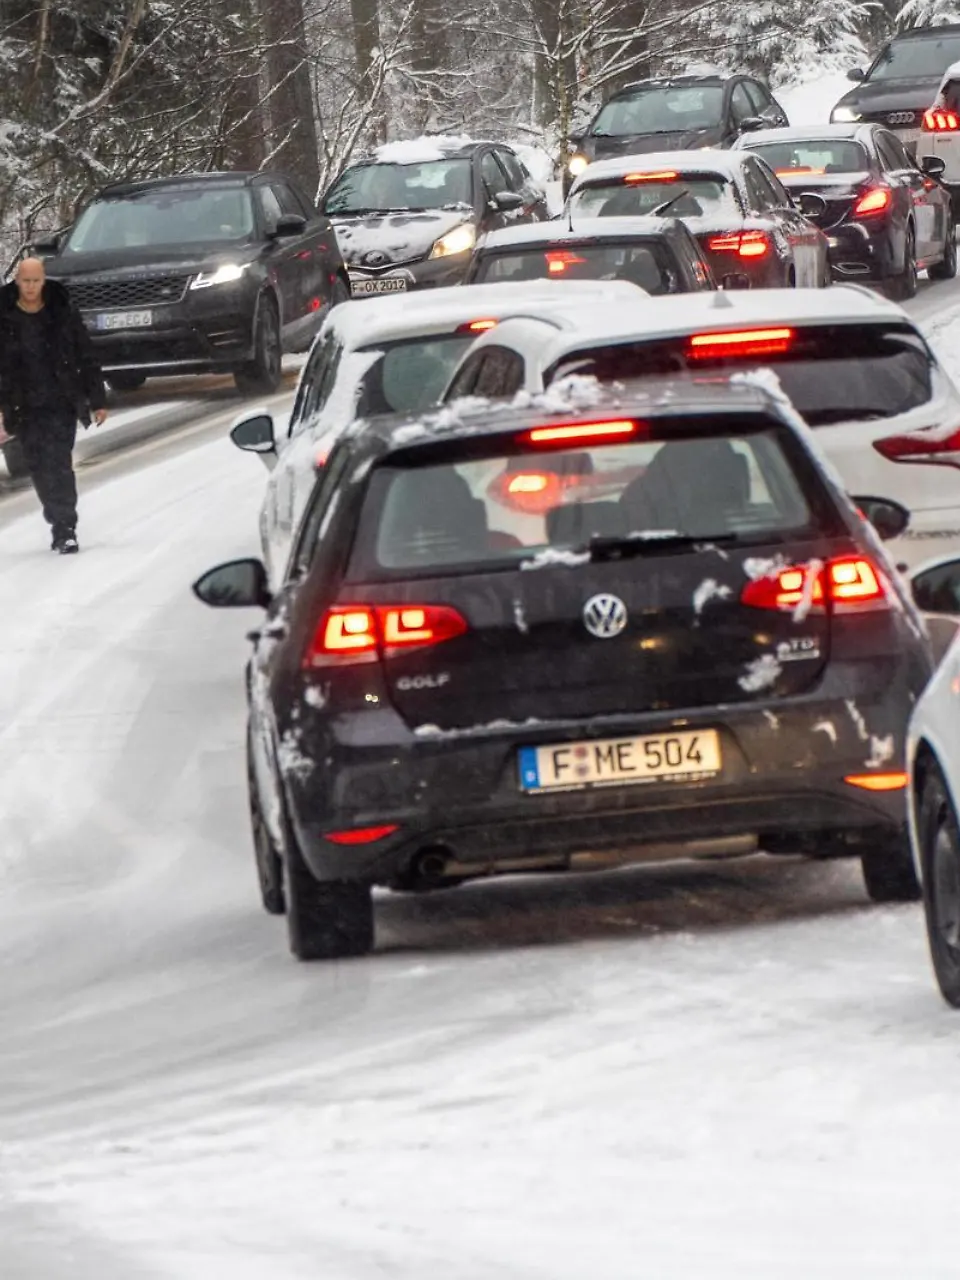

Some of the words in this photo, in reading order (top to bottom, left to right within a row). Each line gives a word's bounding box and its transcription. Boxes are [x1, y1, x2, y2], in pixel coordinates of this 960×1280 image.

[380, 279, 405, 292] 2012
[397, 672, 450, 690] GOLF
[552, 748, 571, 780] F
[594, 741, 636, 774] ME
[643, 736, 704, 769] 504
